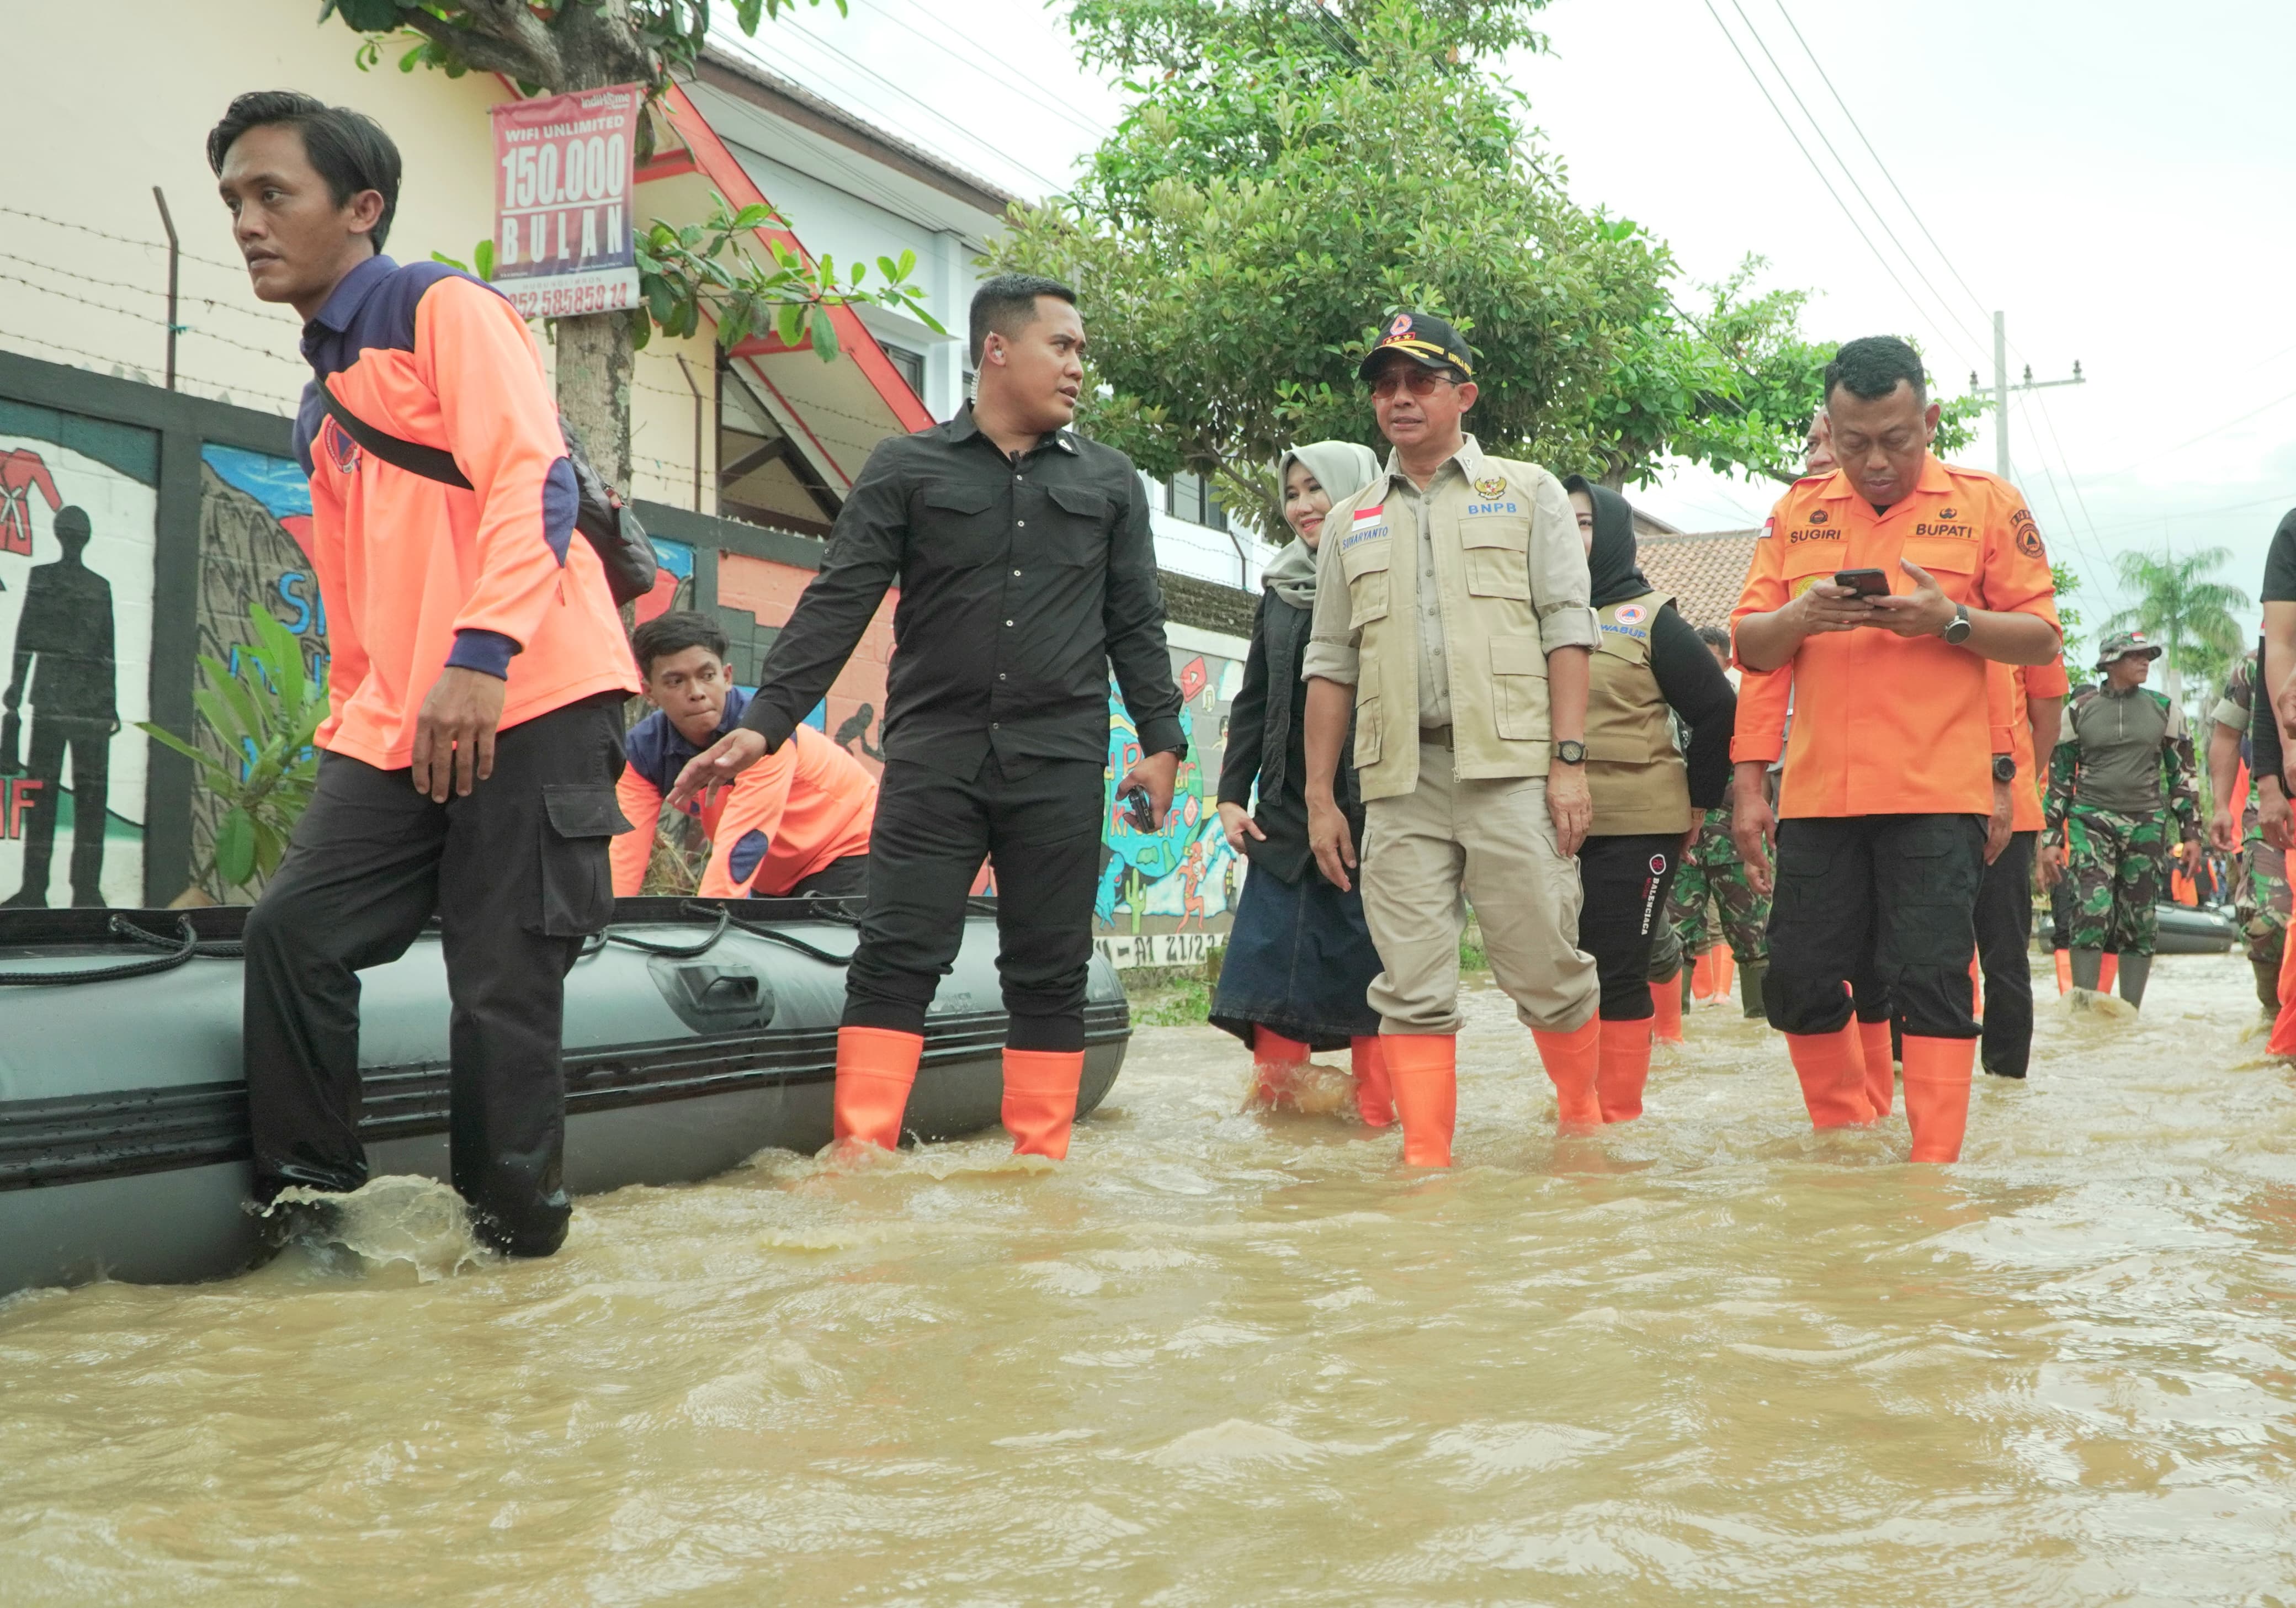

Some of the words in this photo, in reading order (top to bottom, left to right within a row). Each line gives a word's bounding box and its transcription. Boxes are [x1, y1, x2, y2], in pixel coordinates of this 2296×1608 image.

[505, 128, 540, 143] WIFI
[543, 115, 625, 139] UNLIMITED
[501, 132, 626, 209] 150.000
[501, 204, 623, 266] BULAN
[1468, 502, 1517, 515] BNPB
[1342, 526, 1389, 551] SUHARYANTO
[1790, 529, 1841, 544] SUGIRI
[1916, 523, 1973, 539] BUPATI
